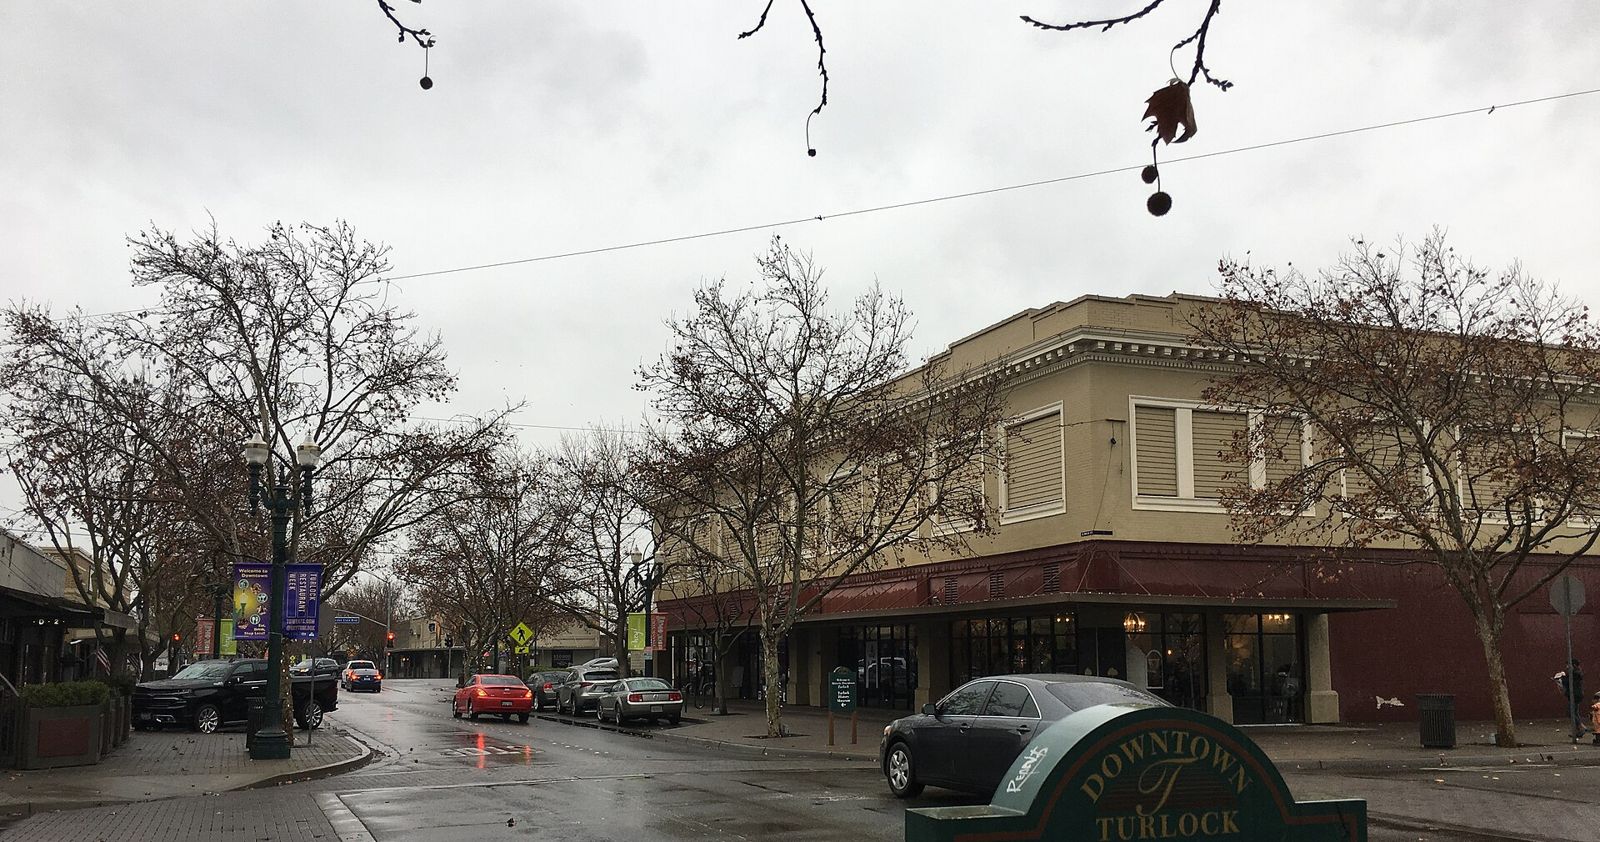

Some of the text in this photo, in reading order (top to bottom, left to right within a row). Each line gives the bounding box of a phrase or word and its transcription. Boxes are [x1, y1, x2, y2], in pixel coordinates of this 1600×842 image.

[288, 573, 297, 591] WEEK
[298, 573, 307, 613] RESTAURANT
[309, 573, 318, 601] TURLOCK
[1080, 729, 1253, 804] DOWNTOWN
[1135, 756, 1199, 816] T
[1096, 810, 1240, 842] TURLOCK
